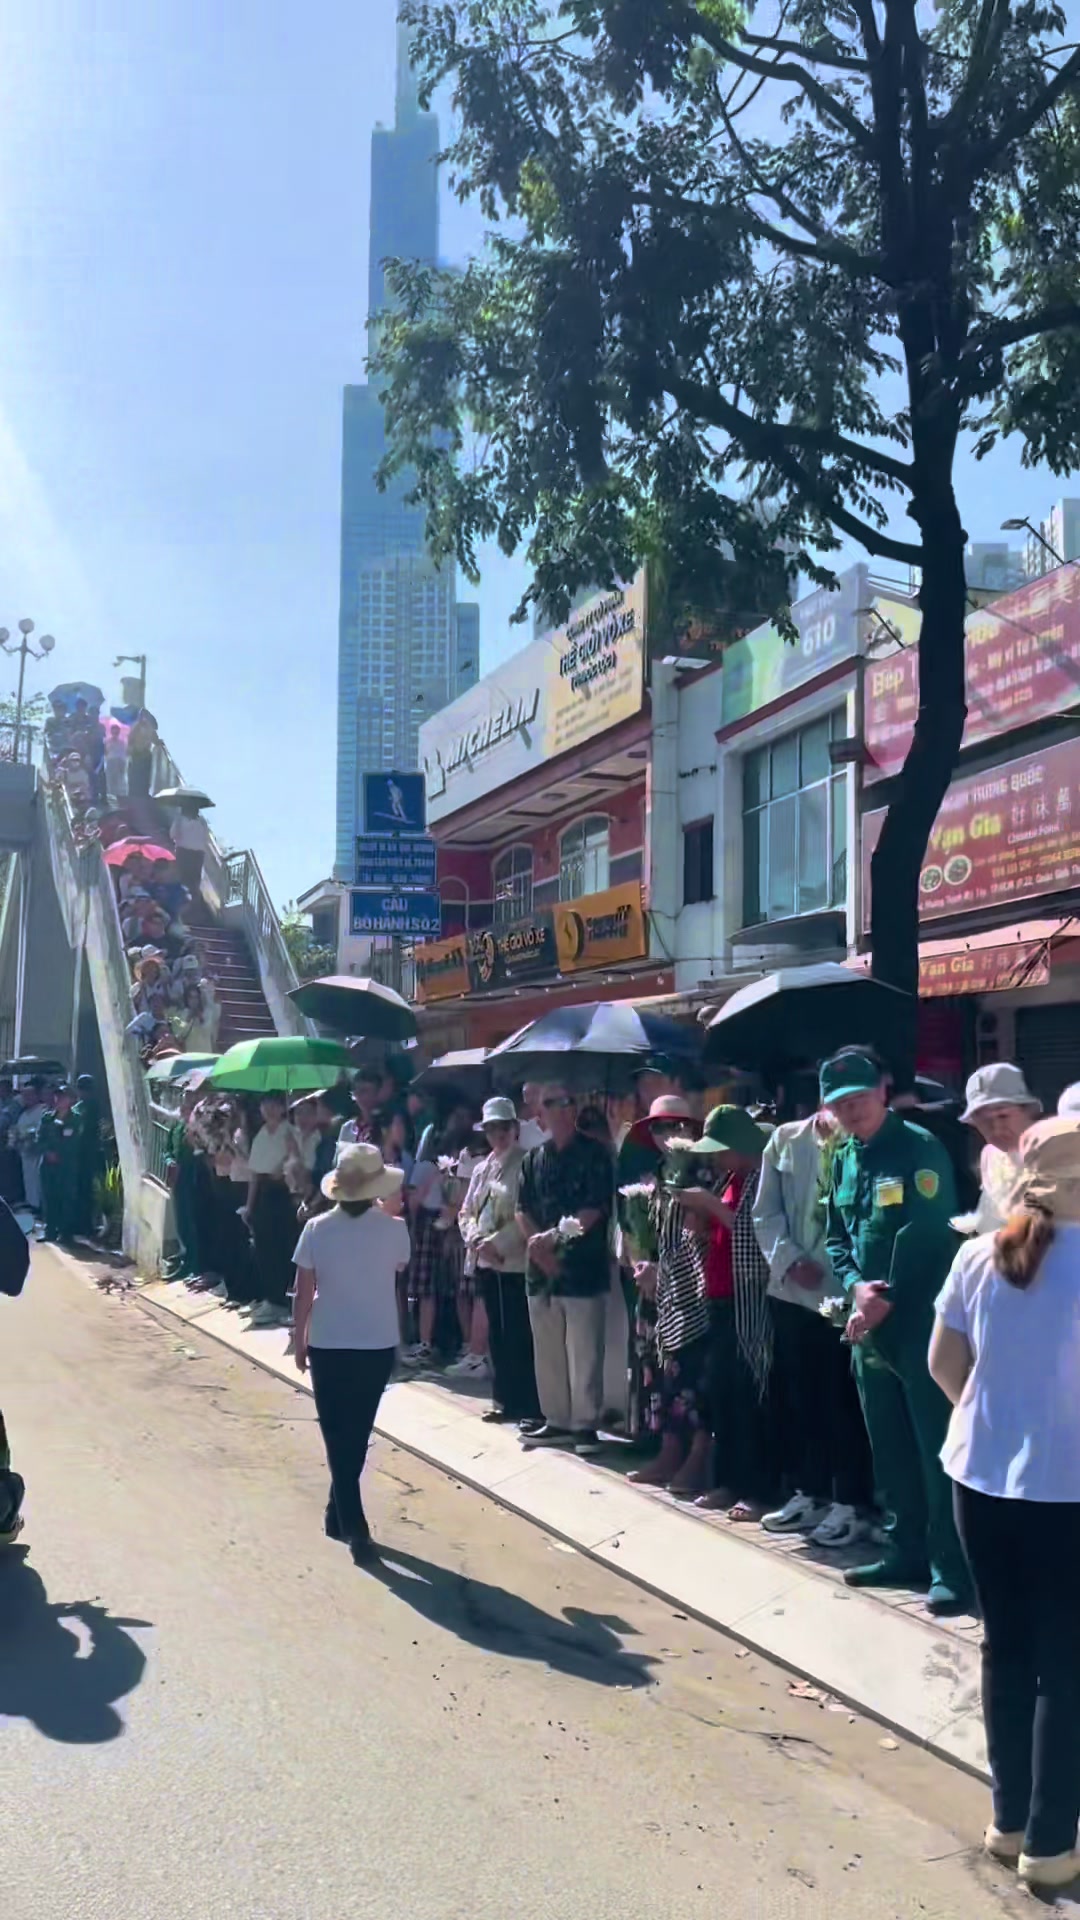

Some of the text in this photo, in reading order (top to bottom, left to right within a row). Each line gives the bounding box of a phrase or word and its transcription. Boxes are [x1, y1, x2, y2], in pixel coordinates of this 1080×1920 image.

[803, 615, 836, 657] 610
[445, 686, 541, 774] MICHELIN
[430, 918, 440, 931] 2
